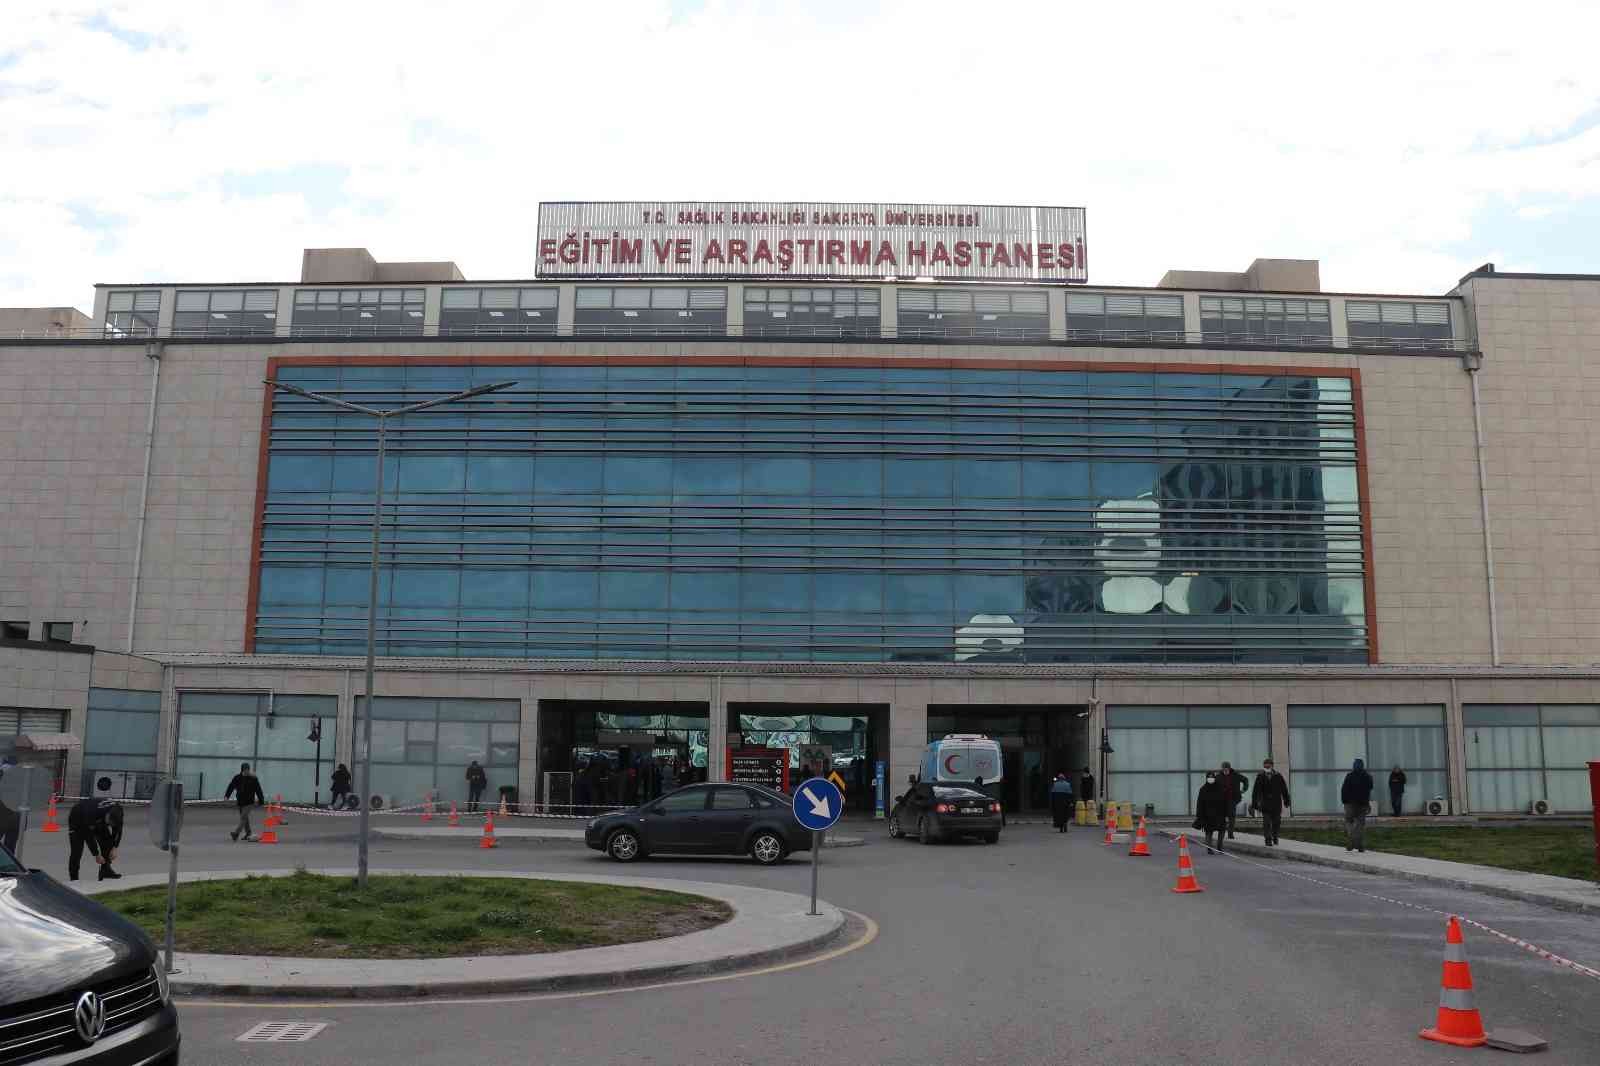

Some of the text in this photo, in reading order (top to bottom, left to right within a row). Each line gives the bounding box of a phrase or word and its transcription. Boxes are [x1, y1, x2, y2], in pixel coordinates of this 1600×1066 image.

[678, 208, 724, 225] SAĞLIK
[731, 208, 805, 226] BAKANLIĞI
[812, 211, 876, 226] SAKARYA
[540, 232, 1085, 272] EĞİTİM VE ARAŞTIRMA HASTANESİ
